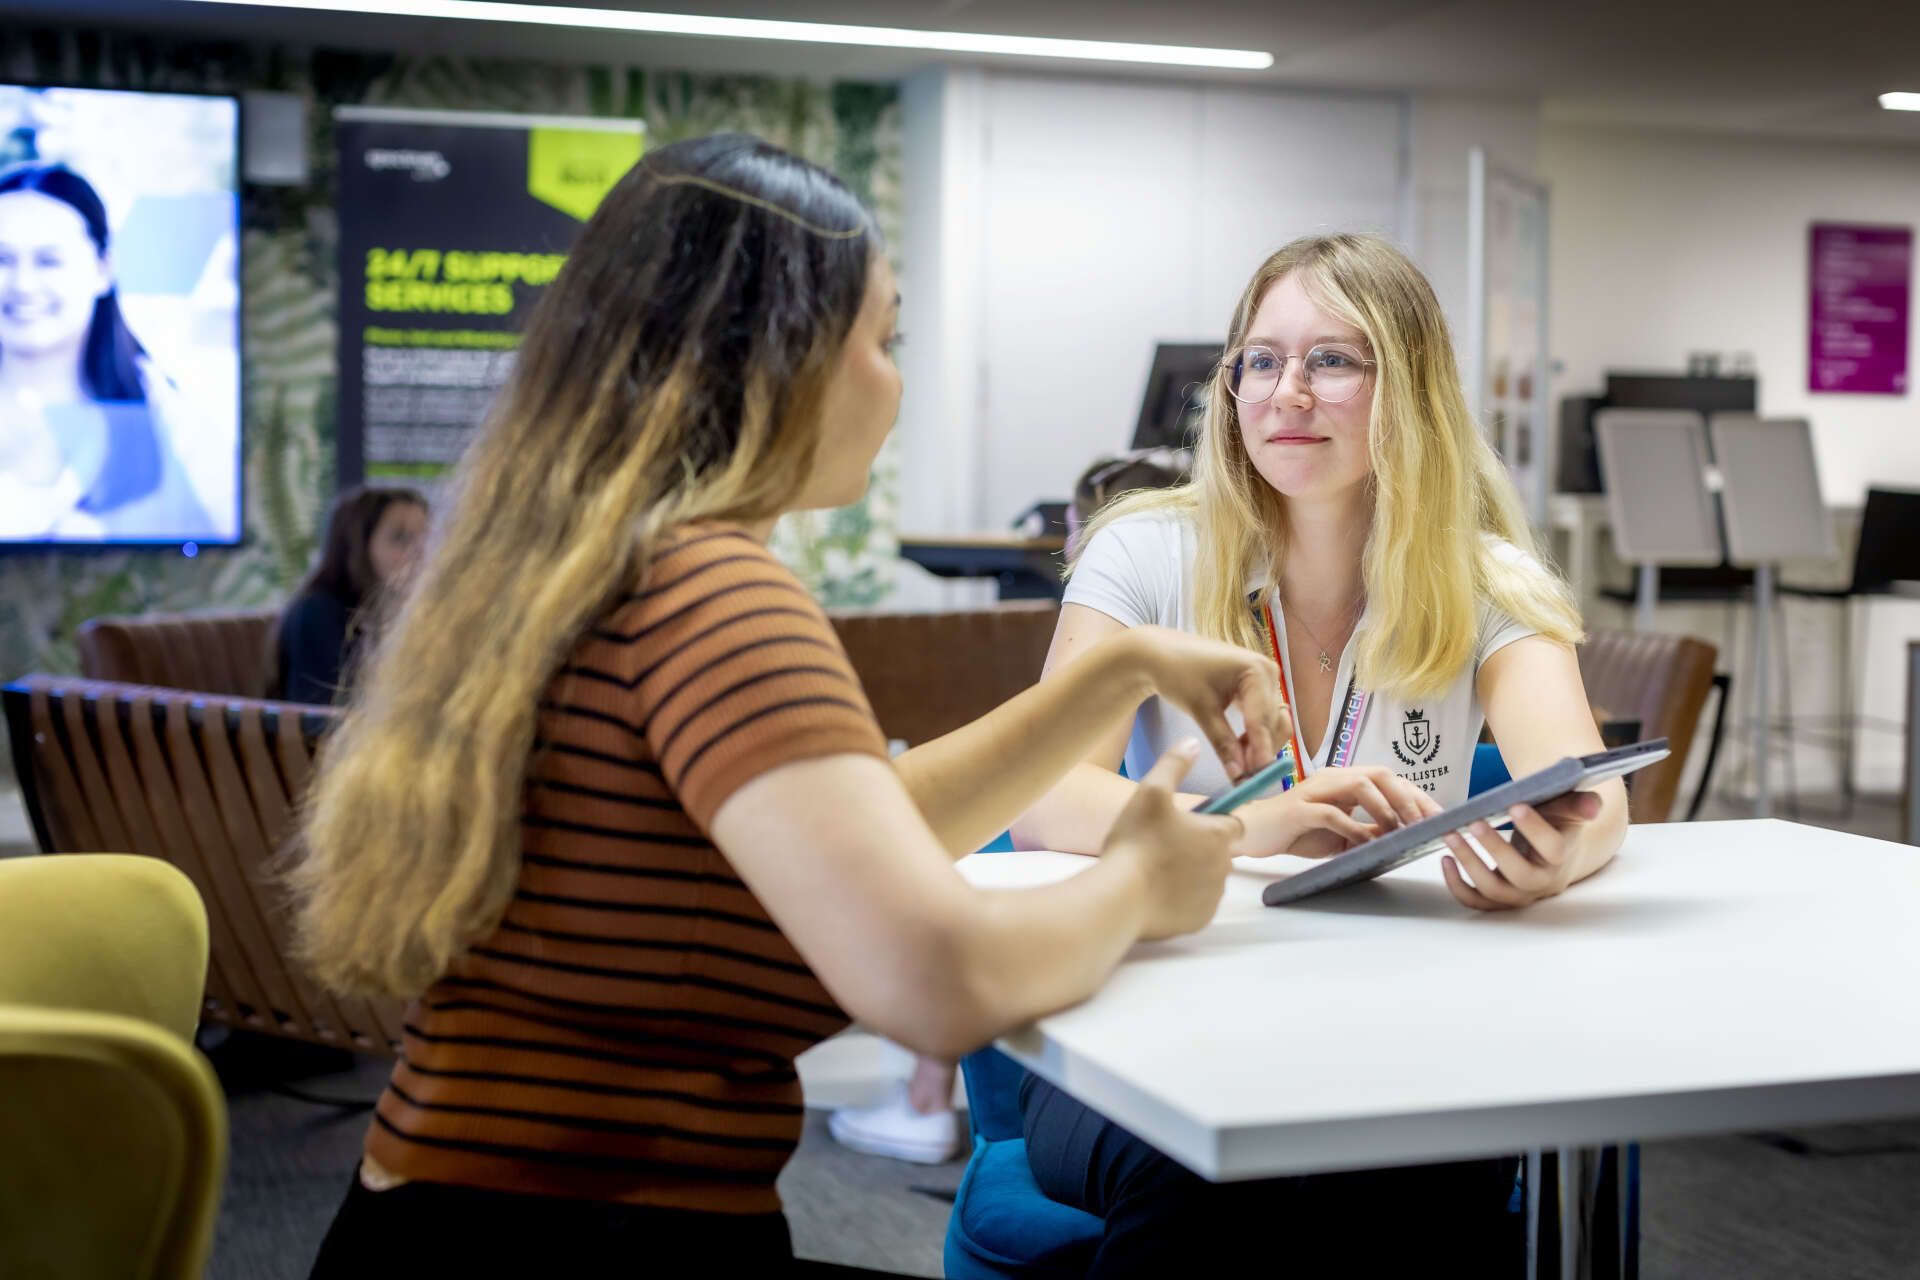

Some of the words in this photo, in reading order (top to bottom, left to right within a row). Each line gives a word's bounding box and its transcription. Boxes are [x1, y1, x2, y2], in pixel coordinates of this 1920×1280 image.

[366, 248, 440, 281] 24/7
[444, 251, 569, 285] SUPPOR
[365, 279, 514, 314] SERVICES
[1346, 687, 1364, 720] KEN
[1340, 721, 1353, 742] OF
[1331, 744, 1348, 768] ITY
[1397, 765, 1450, 781] LLISTER
